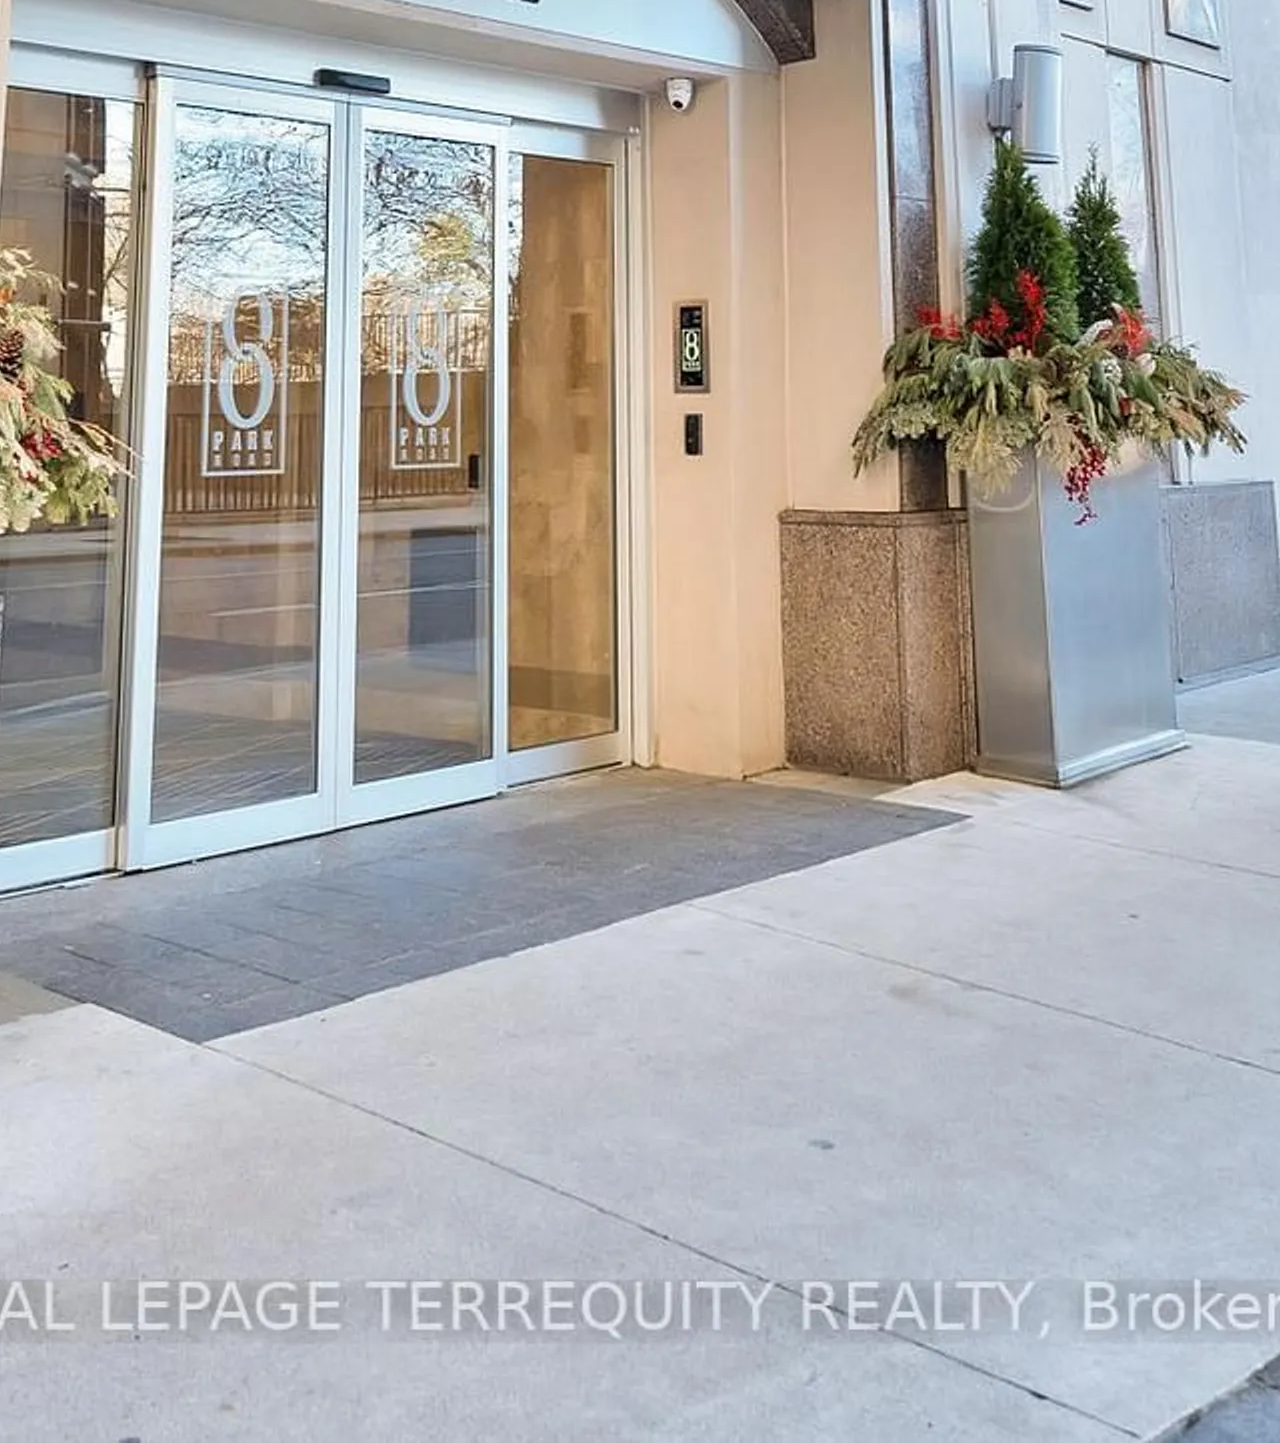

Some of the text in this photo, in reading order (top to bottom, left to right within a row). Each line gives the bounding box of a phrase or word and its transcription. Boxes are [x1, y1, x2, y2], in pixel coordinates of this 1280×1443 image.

[685, 332, 699, 361] 8
[218, 291, 275, 430] 8
[211, 429, 274, 452] PARK
[398, 427, 451, 446] PARK
